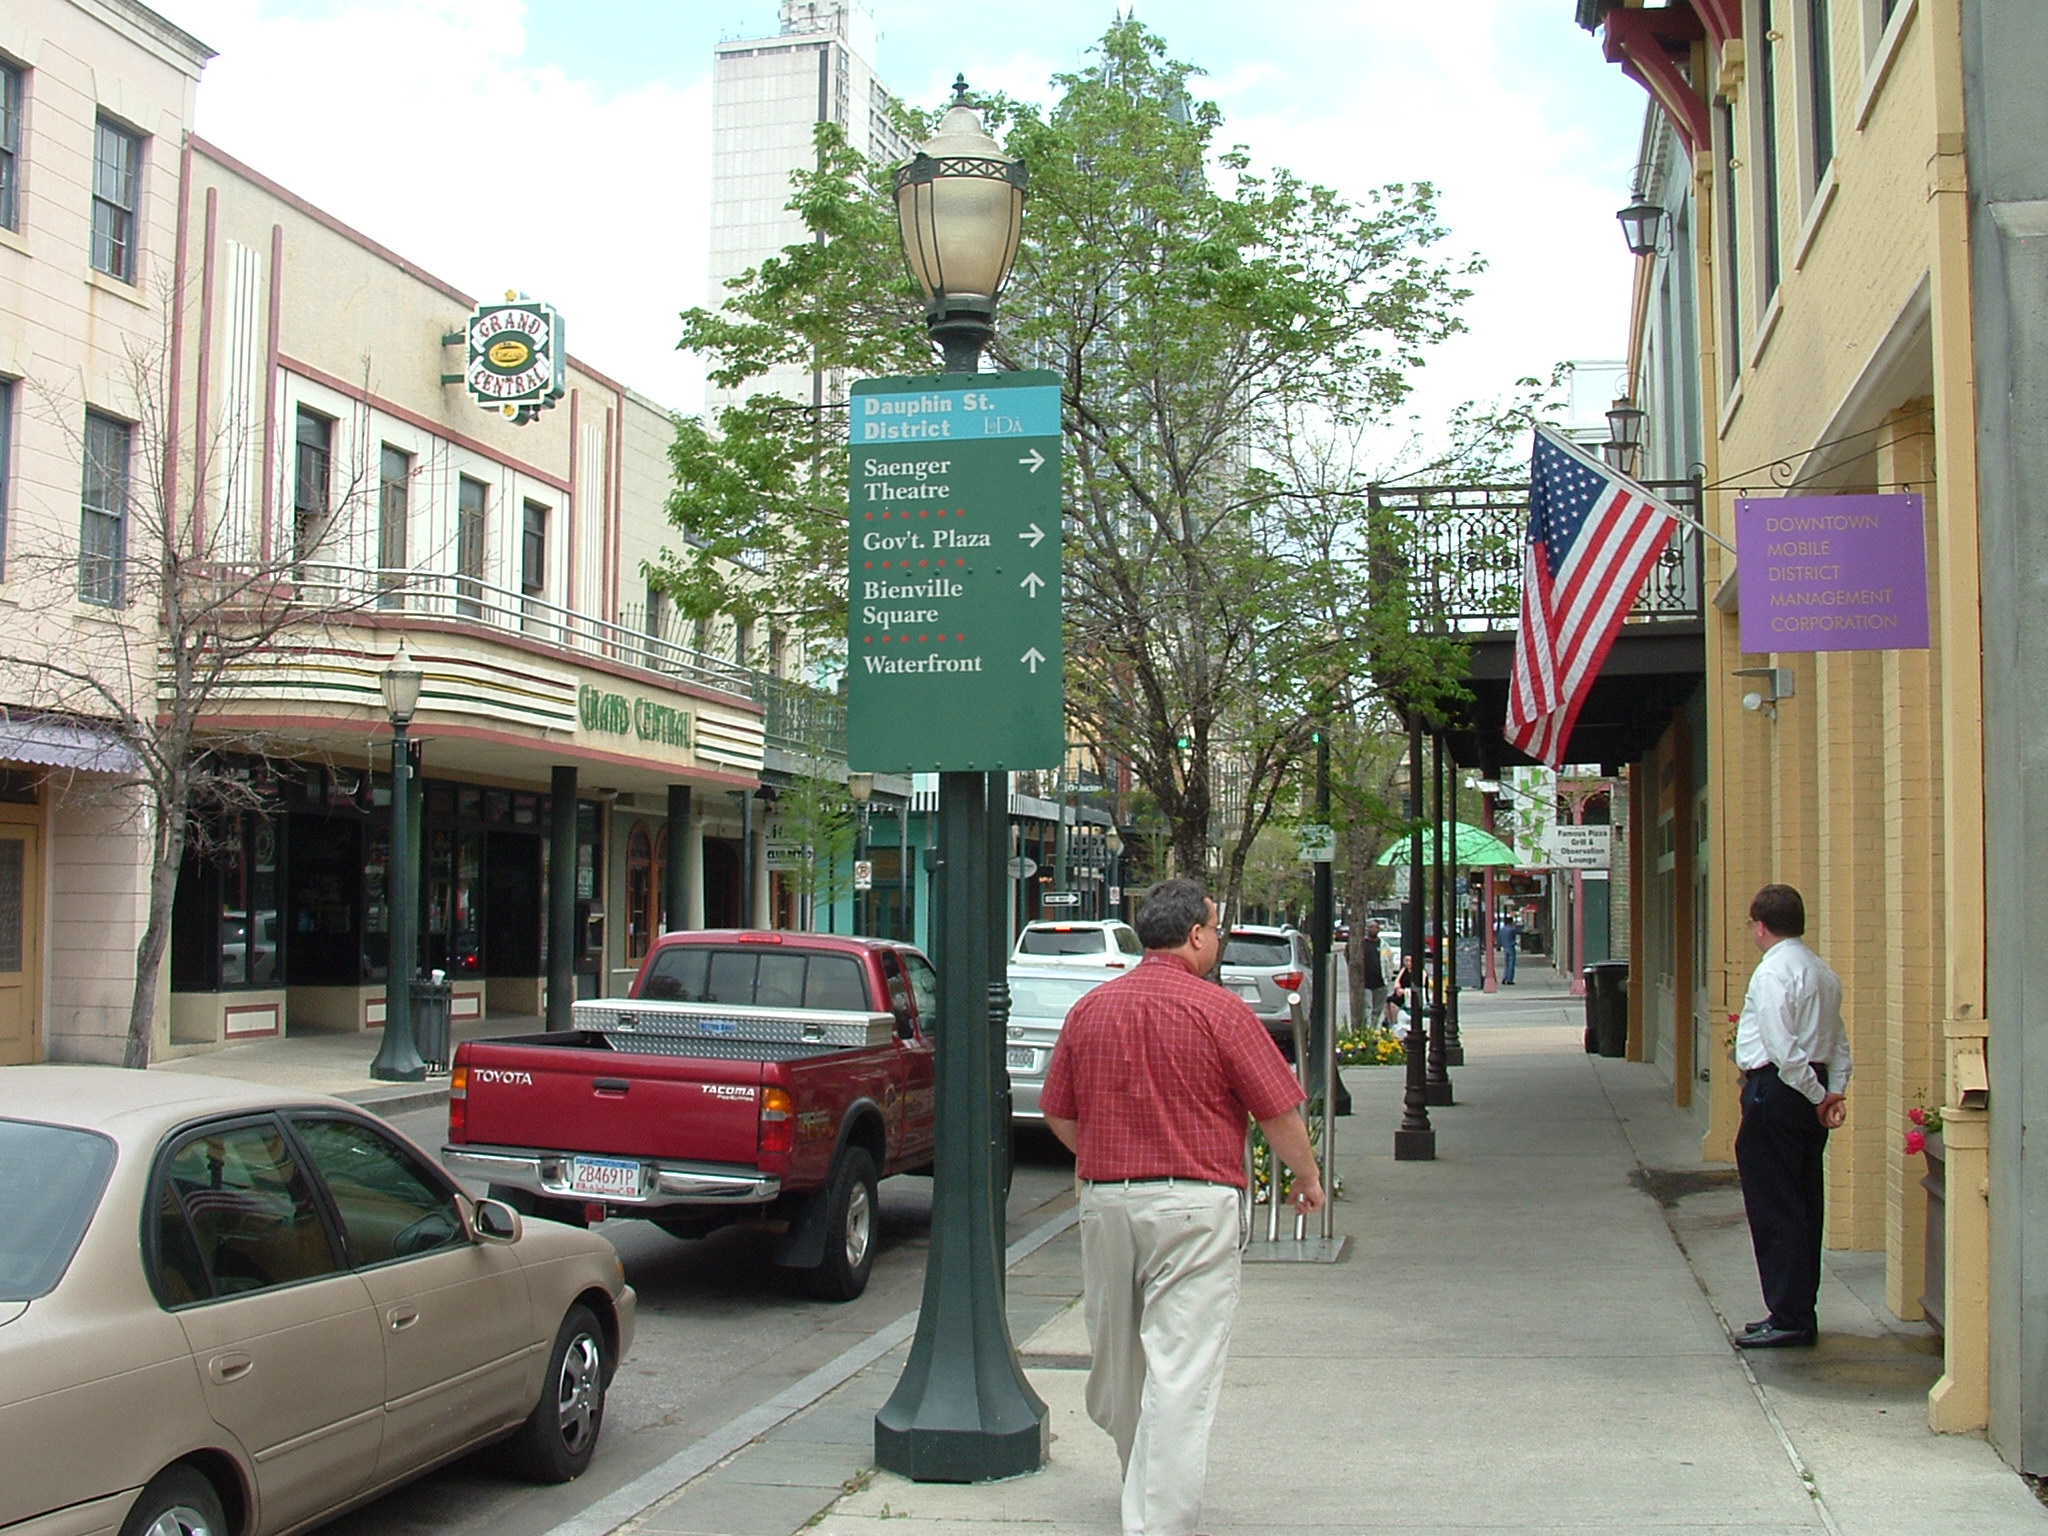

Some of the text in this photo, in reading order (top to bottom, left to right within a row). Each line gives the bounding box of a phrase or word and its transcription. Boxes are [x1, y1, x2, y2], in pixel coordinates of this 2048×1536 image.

[480, 312, 541, 337] GRAND
[474, 367, 546, 396] CENTRAL
[864, 393, 995, 417] Dauphin St.
[864, 420, 951, 440] District
[864, 458, 951, 481] Saenger
[864, 483, 950, 501] Theatre
[1766, 515, 1879, 533] DOWNTOWN
[863, 530, 991, 551] Gov't. Plaza
[1767, 541, 1830, 557] MOBILE
[1769, 565, 1840, 582] DISTRICT
[864, 579, 963, 600] Bienville
[1770, 589, 1893, 607] MANAGEMENT
[863, 608, 939, 629] Square
[1772, 614, 1898, 632] CORPORATION
[864, 654, 983, 675] Waterfront
[579, 684, 692, 749] GRAND CENTRAL
[1588, 829, 1607, 837] Pizza
[1561, 847, 1605, 855] Observation
[1568, 856, 1597, 865] Lounge
[474, 1069, 532, 1086] TOYOTA
[702, 1084, 755, 1096] TACOMA
[578, 1165, 634, 1186] 2B4691P
